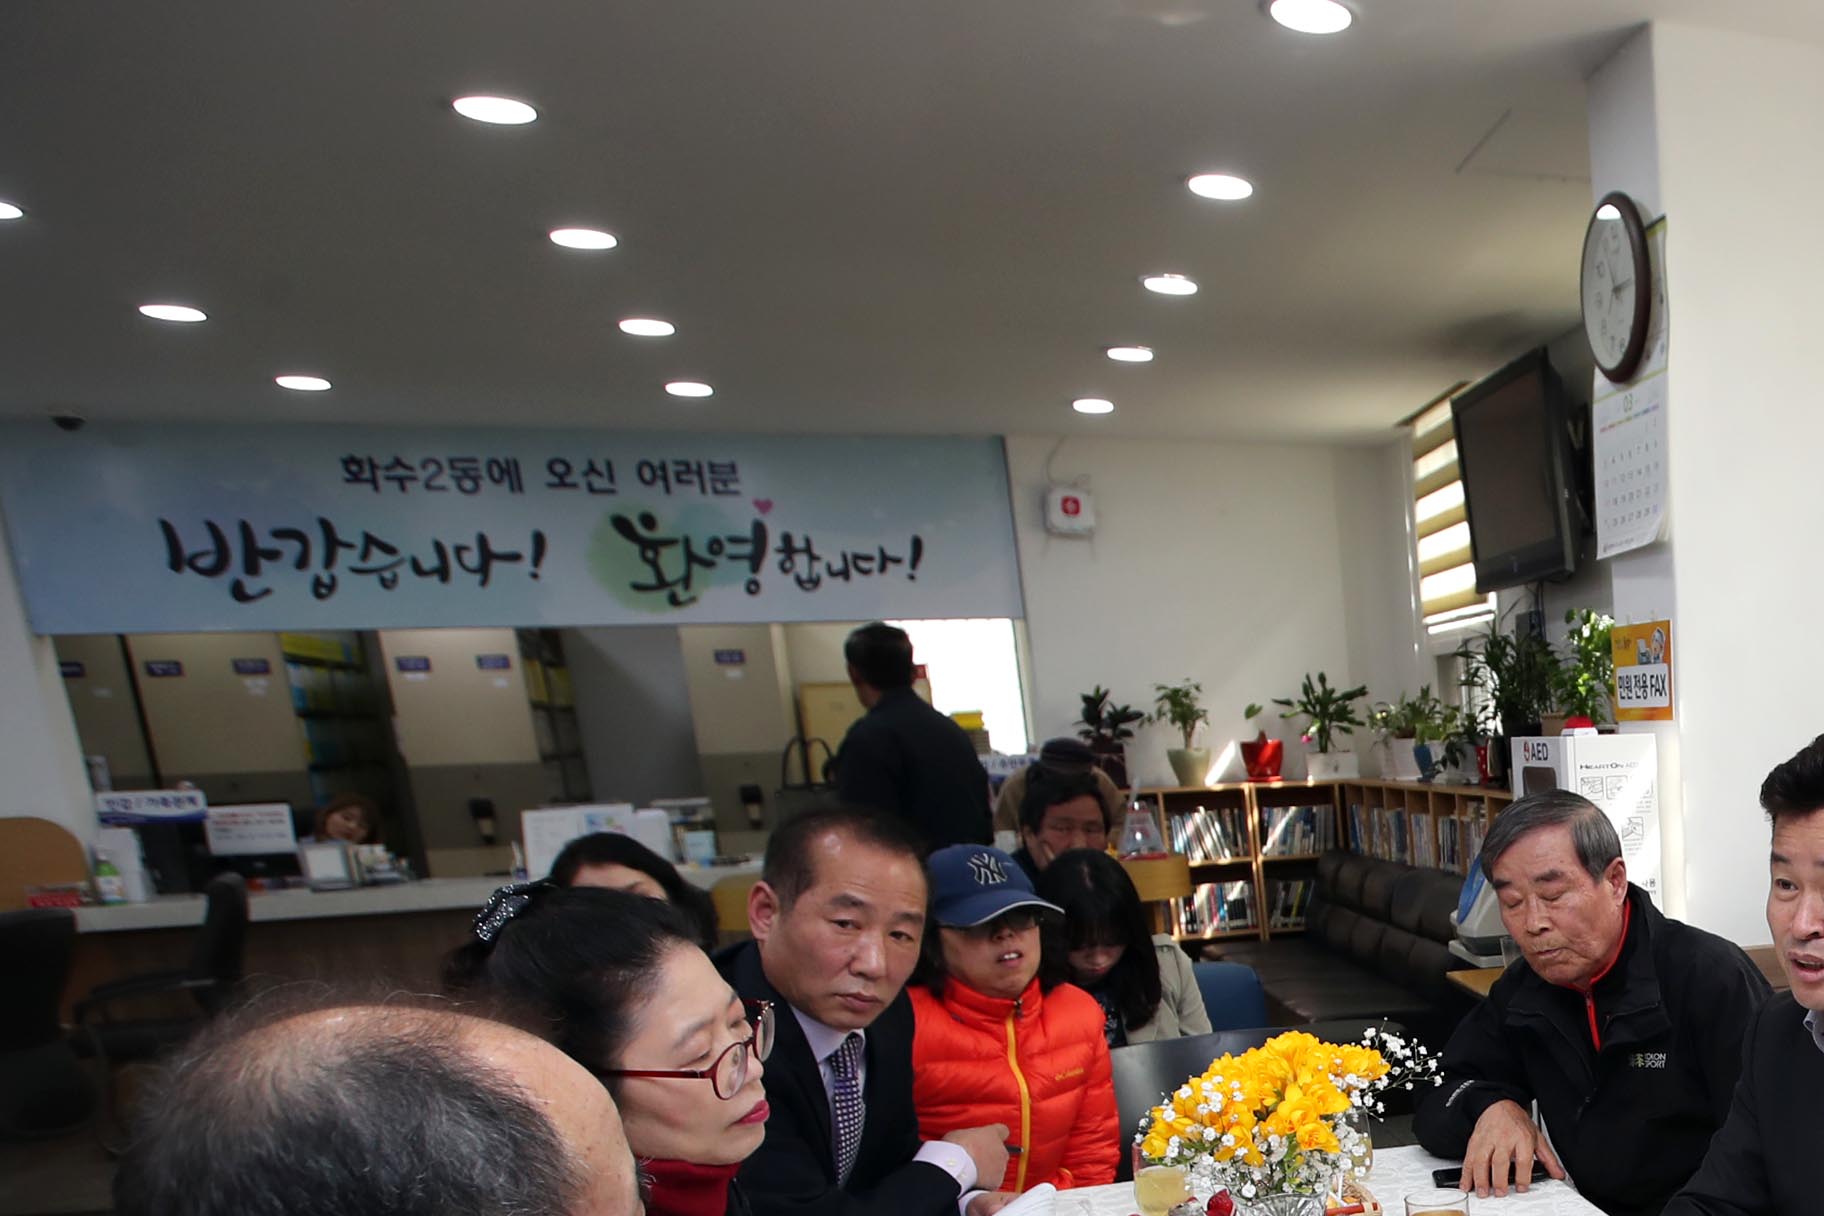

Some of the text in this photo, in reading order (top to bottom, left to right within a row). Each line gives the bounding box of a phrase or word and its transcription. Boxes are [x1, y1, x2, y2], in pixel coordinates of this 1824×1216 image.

[340, 455, 743, 498] 화수2동에 오신 여러분
[157, 511, 925, 608] 반갑습니다! 환영합니다!
[1618, 673, 1667, 700] 민원 전용 FAX
[1531, 742, 1549, 761] AED
